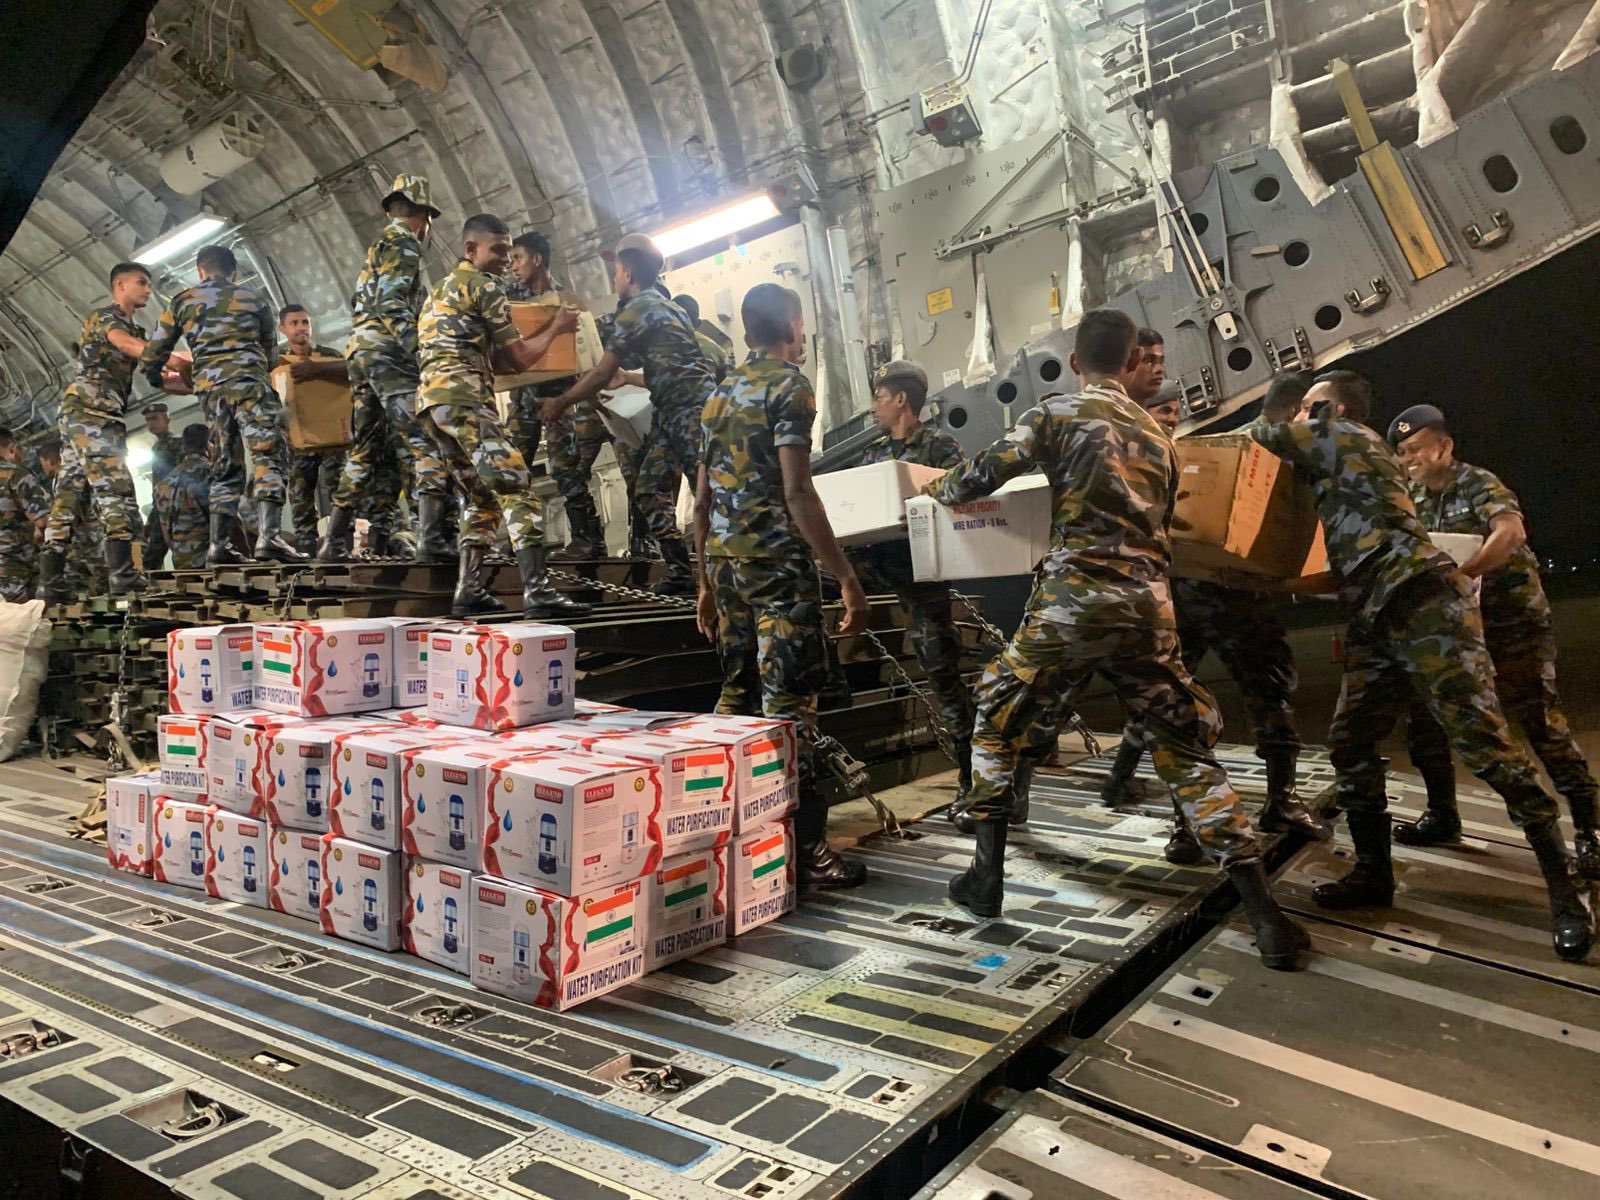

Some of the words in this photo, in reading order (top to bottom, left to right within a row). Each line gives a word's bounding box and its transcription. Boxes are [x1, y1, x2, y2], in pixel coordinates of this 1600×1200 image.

[966, 518, 986, 530] RATION
[231, 690, 252, 707] WATER
[407, 680, 427, 694] WATER
[743, 800, 759, 821] WATER
[760, 785, 788, 814] PURIFICATION
[667, 815, 685, 836] WATER
[686, 808, 721, 832] PURIFICATION
[721, 807, 730, 824] KIT
[742, 906, 758, 926] WATER
[655, 935, 675, 958] WATER
[676, 924, 713, 951] PURIFICATION
[714, 920, 724, 938] KIT
[566, 975, 589, 1001] WATER
[590, 960, 631, 993] PURIFICATION
[632, 954, 642, 976] KIT
